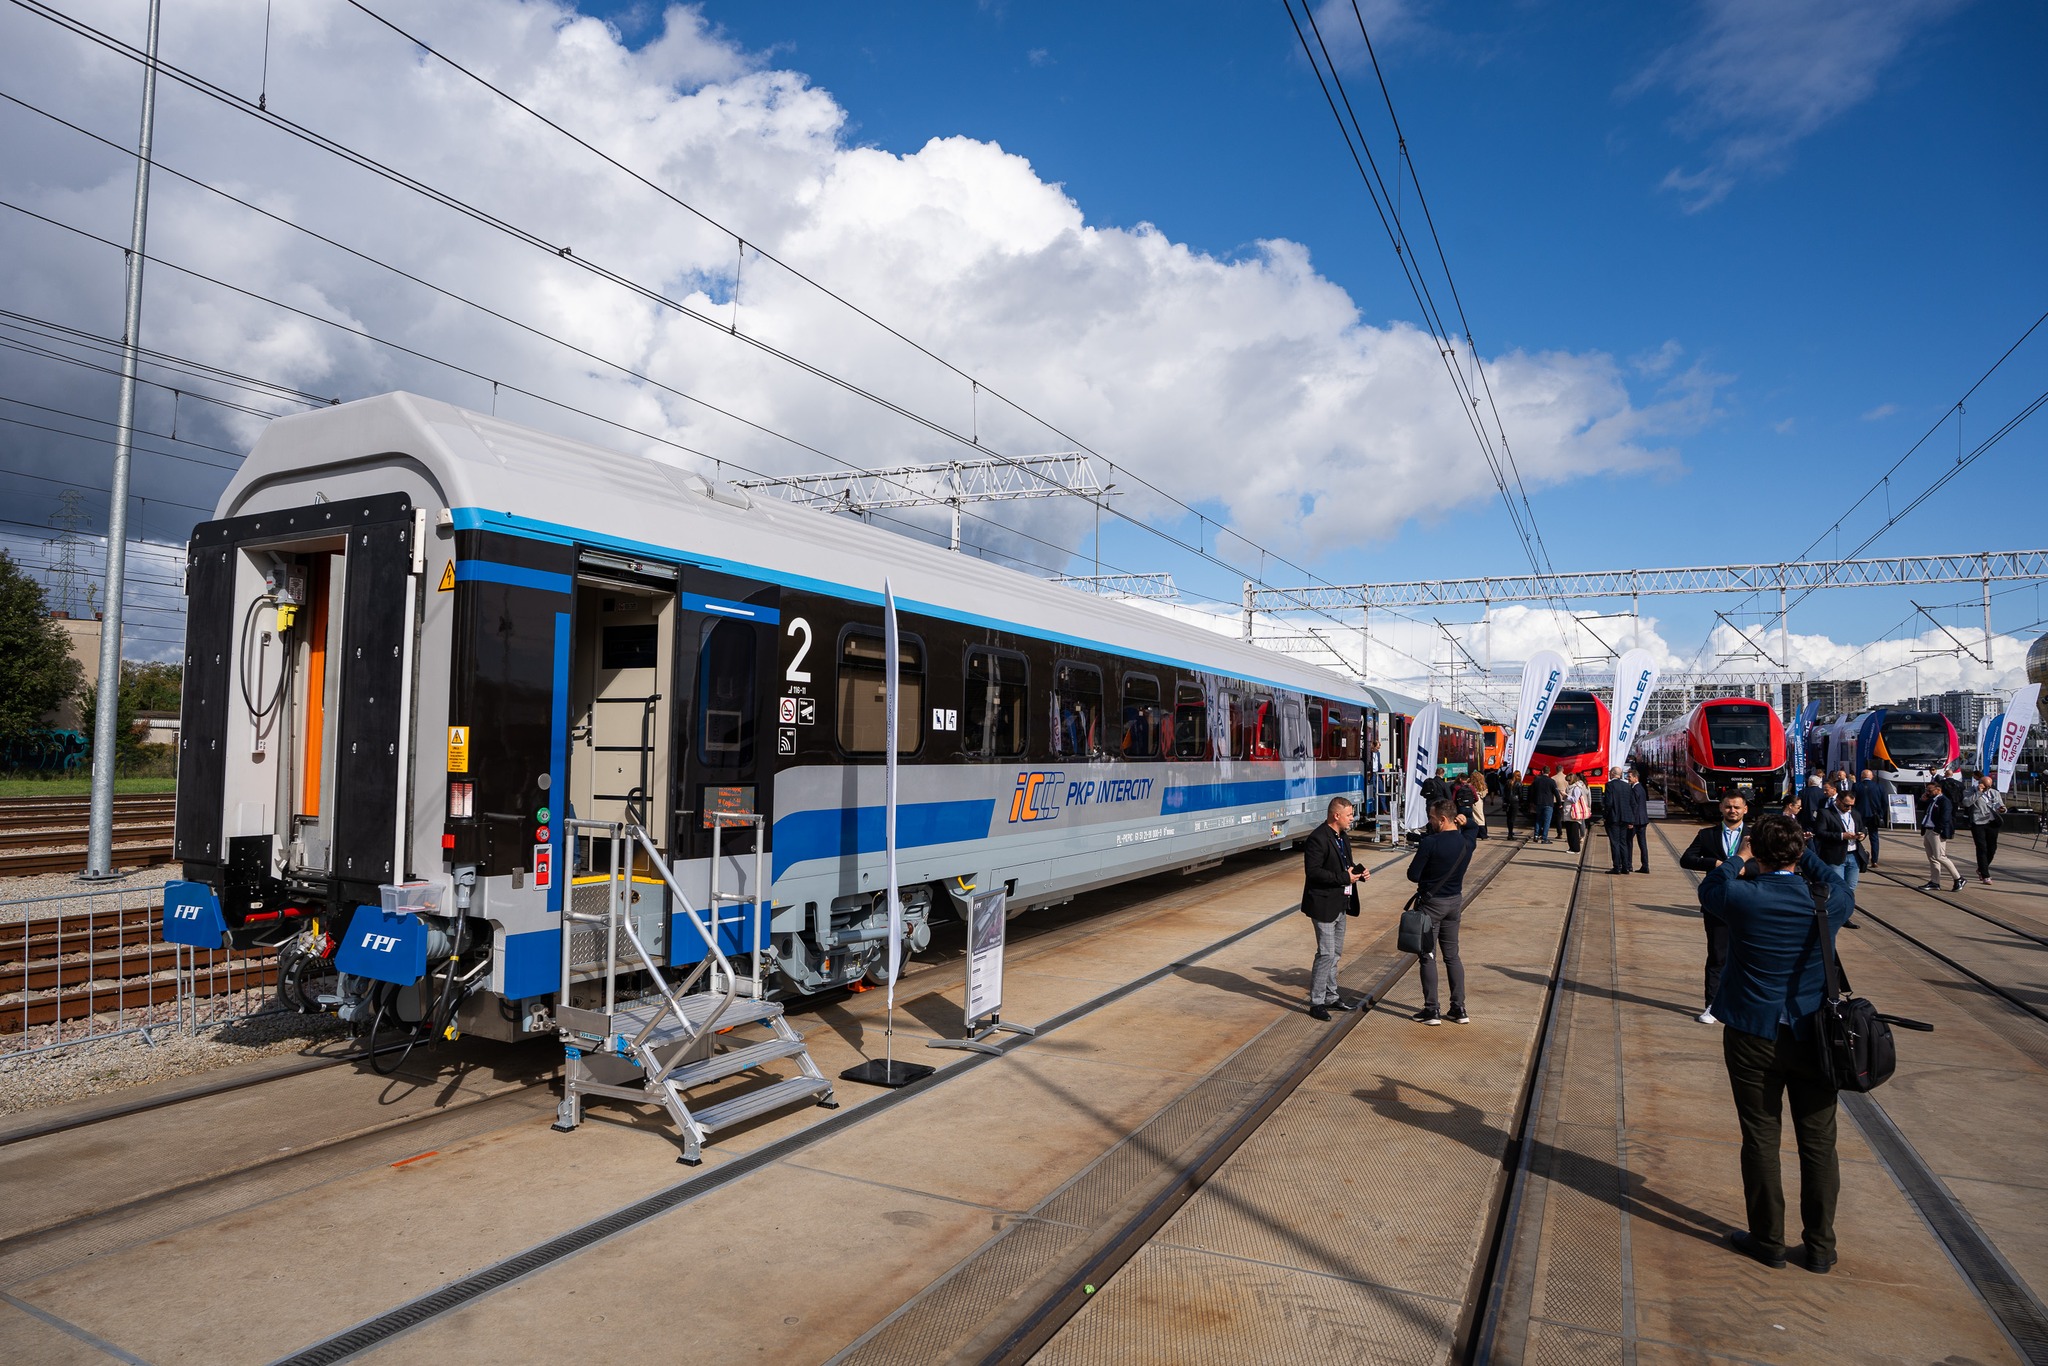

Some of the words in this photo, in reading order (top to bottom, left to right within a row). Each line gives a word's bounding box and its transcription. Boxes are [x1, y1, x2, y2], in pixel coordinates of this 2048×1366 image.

[786, 617, 812, 683] 2
[1525, 670, 1560, 741] STADLER
[1618, 669, 1652, 743] STADLER
[2001, 721, 2018, 762] 300
[2008, 724, 2026, 763] IMPULS
[1066, 780, 1095, 806] PKP
[1096, 778, 1154, 804] INTERCITY
[174, 904, 203, 921] FPS
[361, 932, 402, 953] FPS
